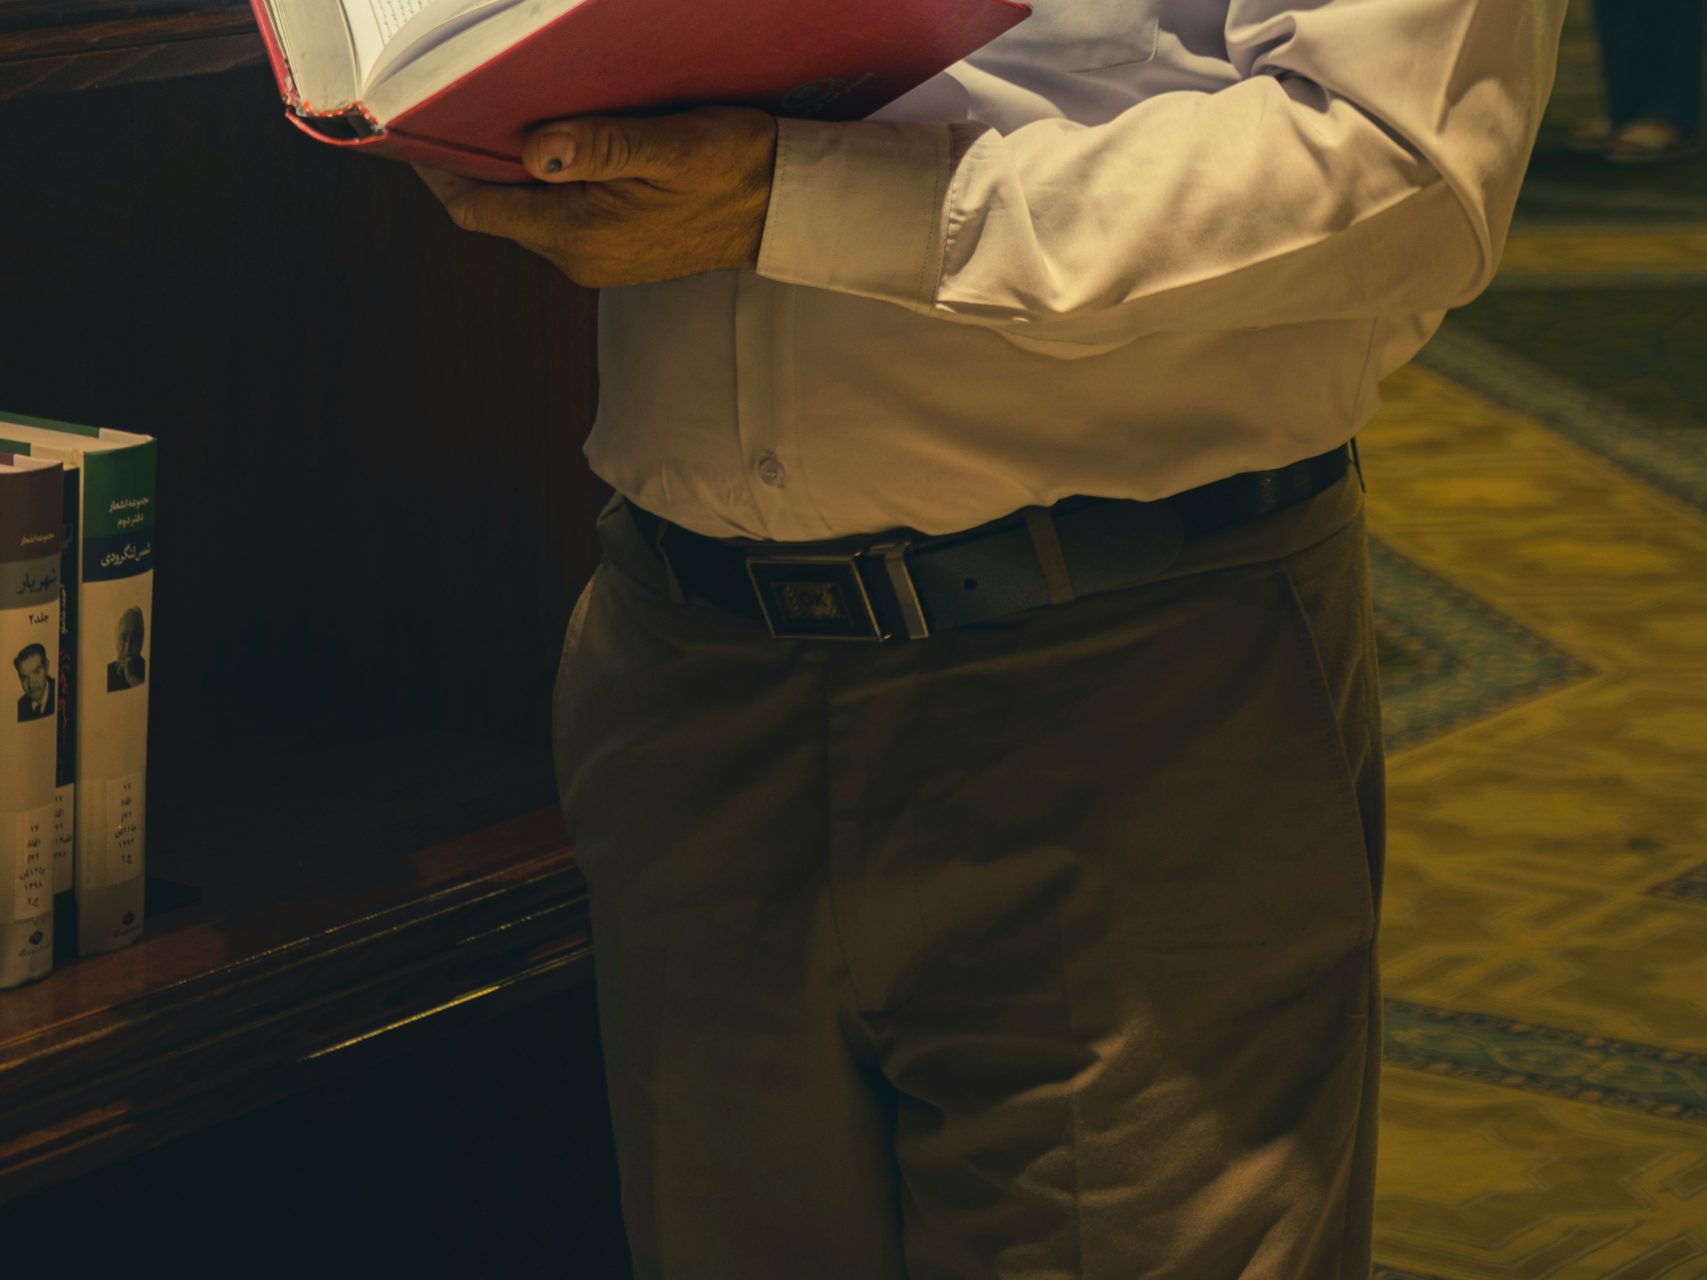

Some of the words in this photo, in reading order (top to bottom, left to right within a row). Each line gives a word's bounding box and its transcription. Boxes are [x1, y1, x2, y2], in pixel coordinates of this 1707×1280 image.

[108, 498, 128, 513] اشعار
[127, 497, 150, 509] مجموعه
[116, 516, 130, 529] دوم
[130, 513, 145, 527] دفتر
[100, 544, 136, 567] لنگرودی
[16, 567, 57, 594] شهریار
